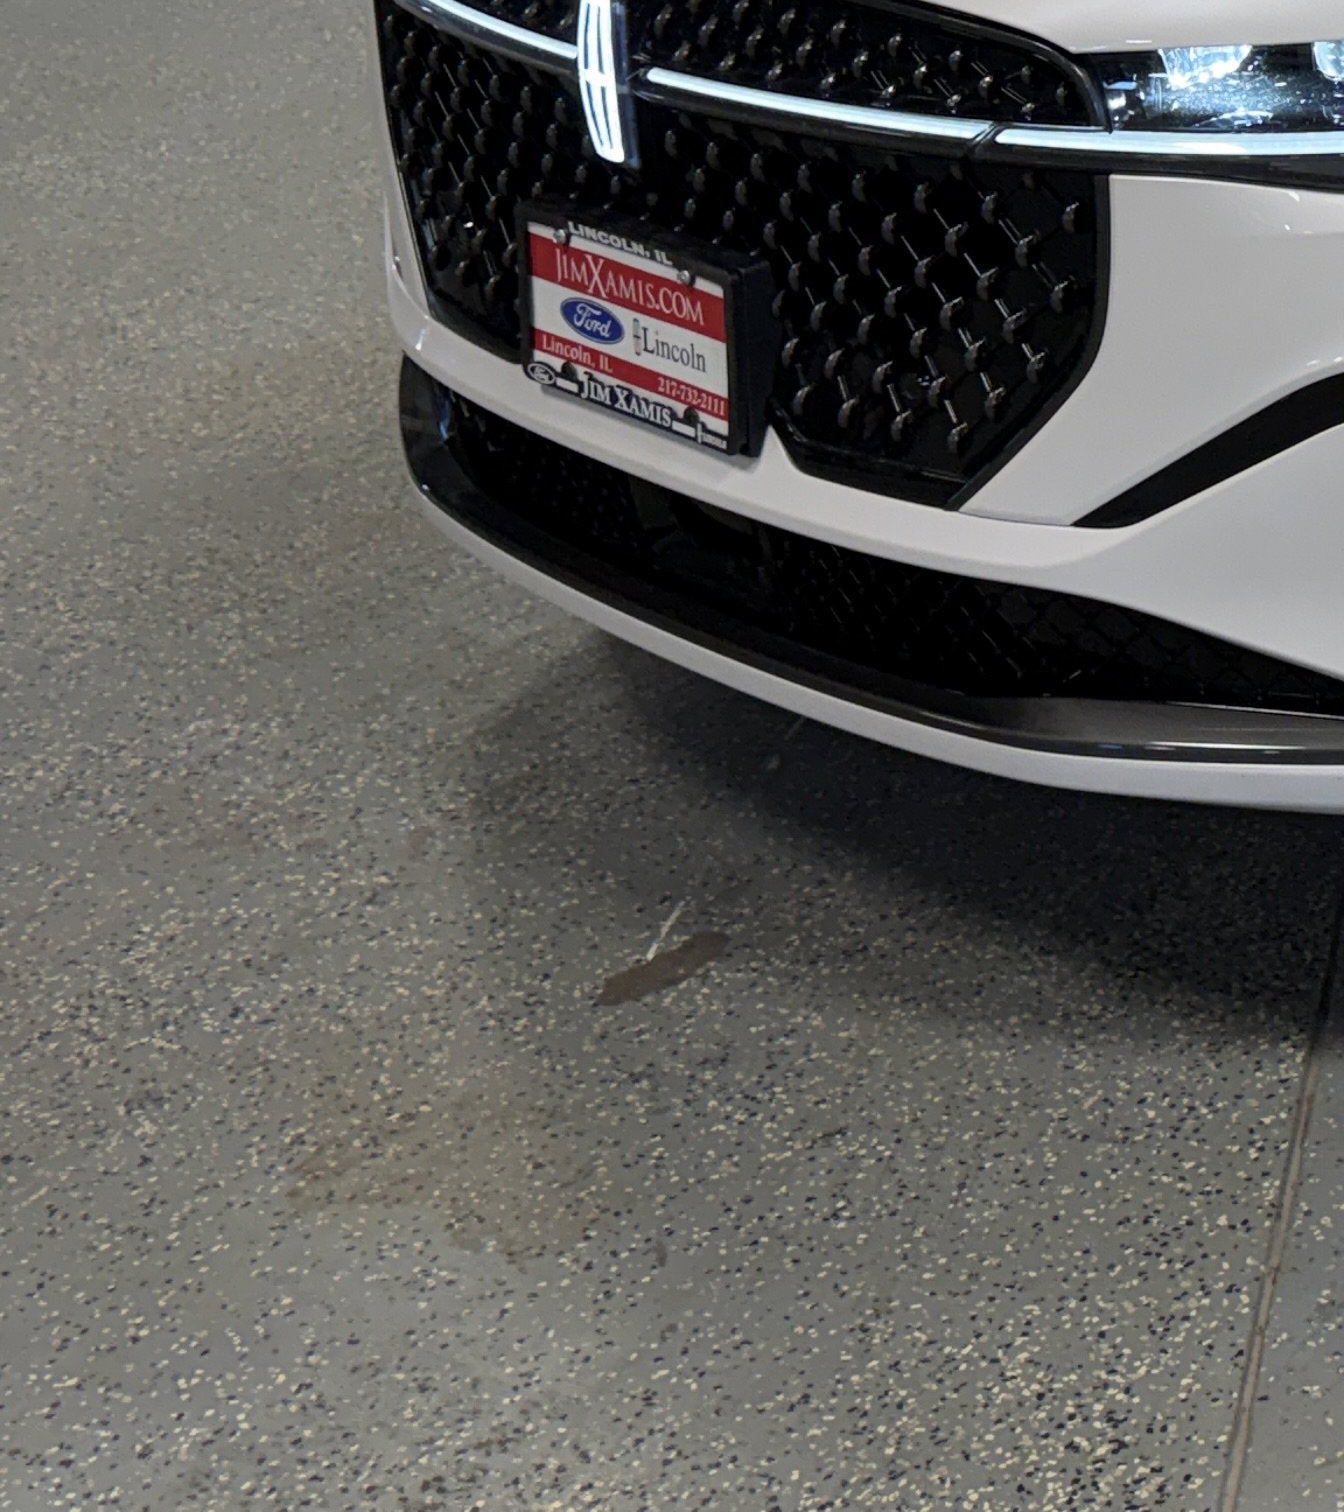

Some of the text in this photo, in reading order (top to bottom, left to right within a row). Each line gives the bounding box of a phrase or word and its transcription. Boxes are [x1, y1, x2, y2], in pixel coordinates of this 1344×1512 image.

[568, 221, 674, 266] LINCOLN, IL
[573, 303, 612, 338] Ford
[542, 334, 614, 373] Lincoln, IL
[642, 327, 706, 373] Lincoln
[580, 371, 611, 406] JIM
[613, 386, 672, 428] XAMIS
[657, 377, 725, 416] 217-732-2111
